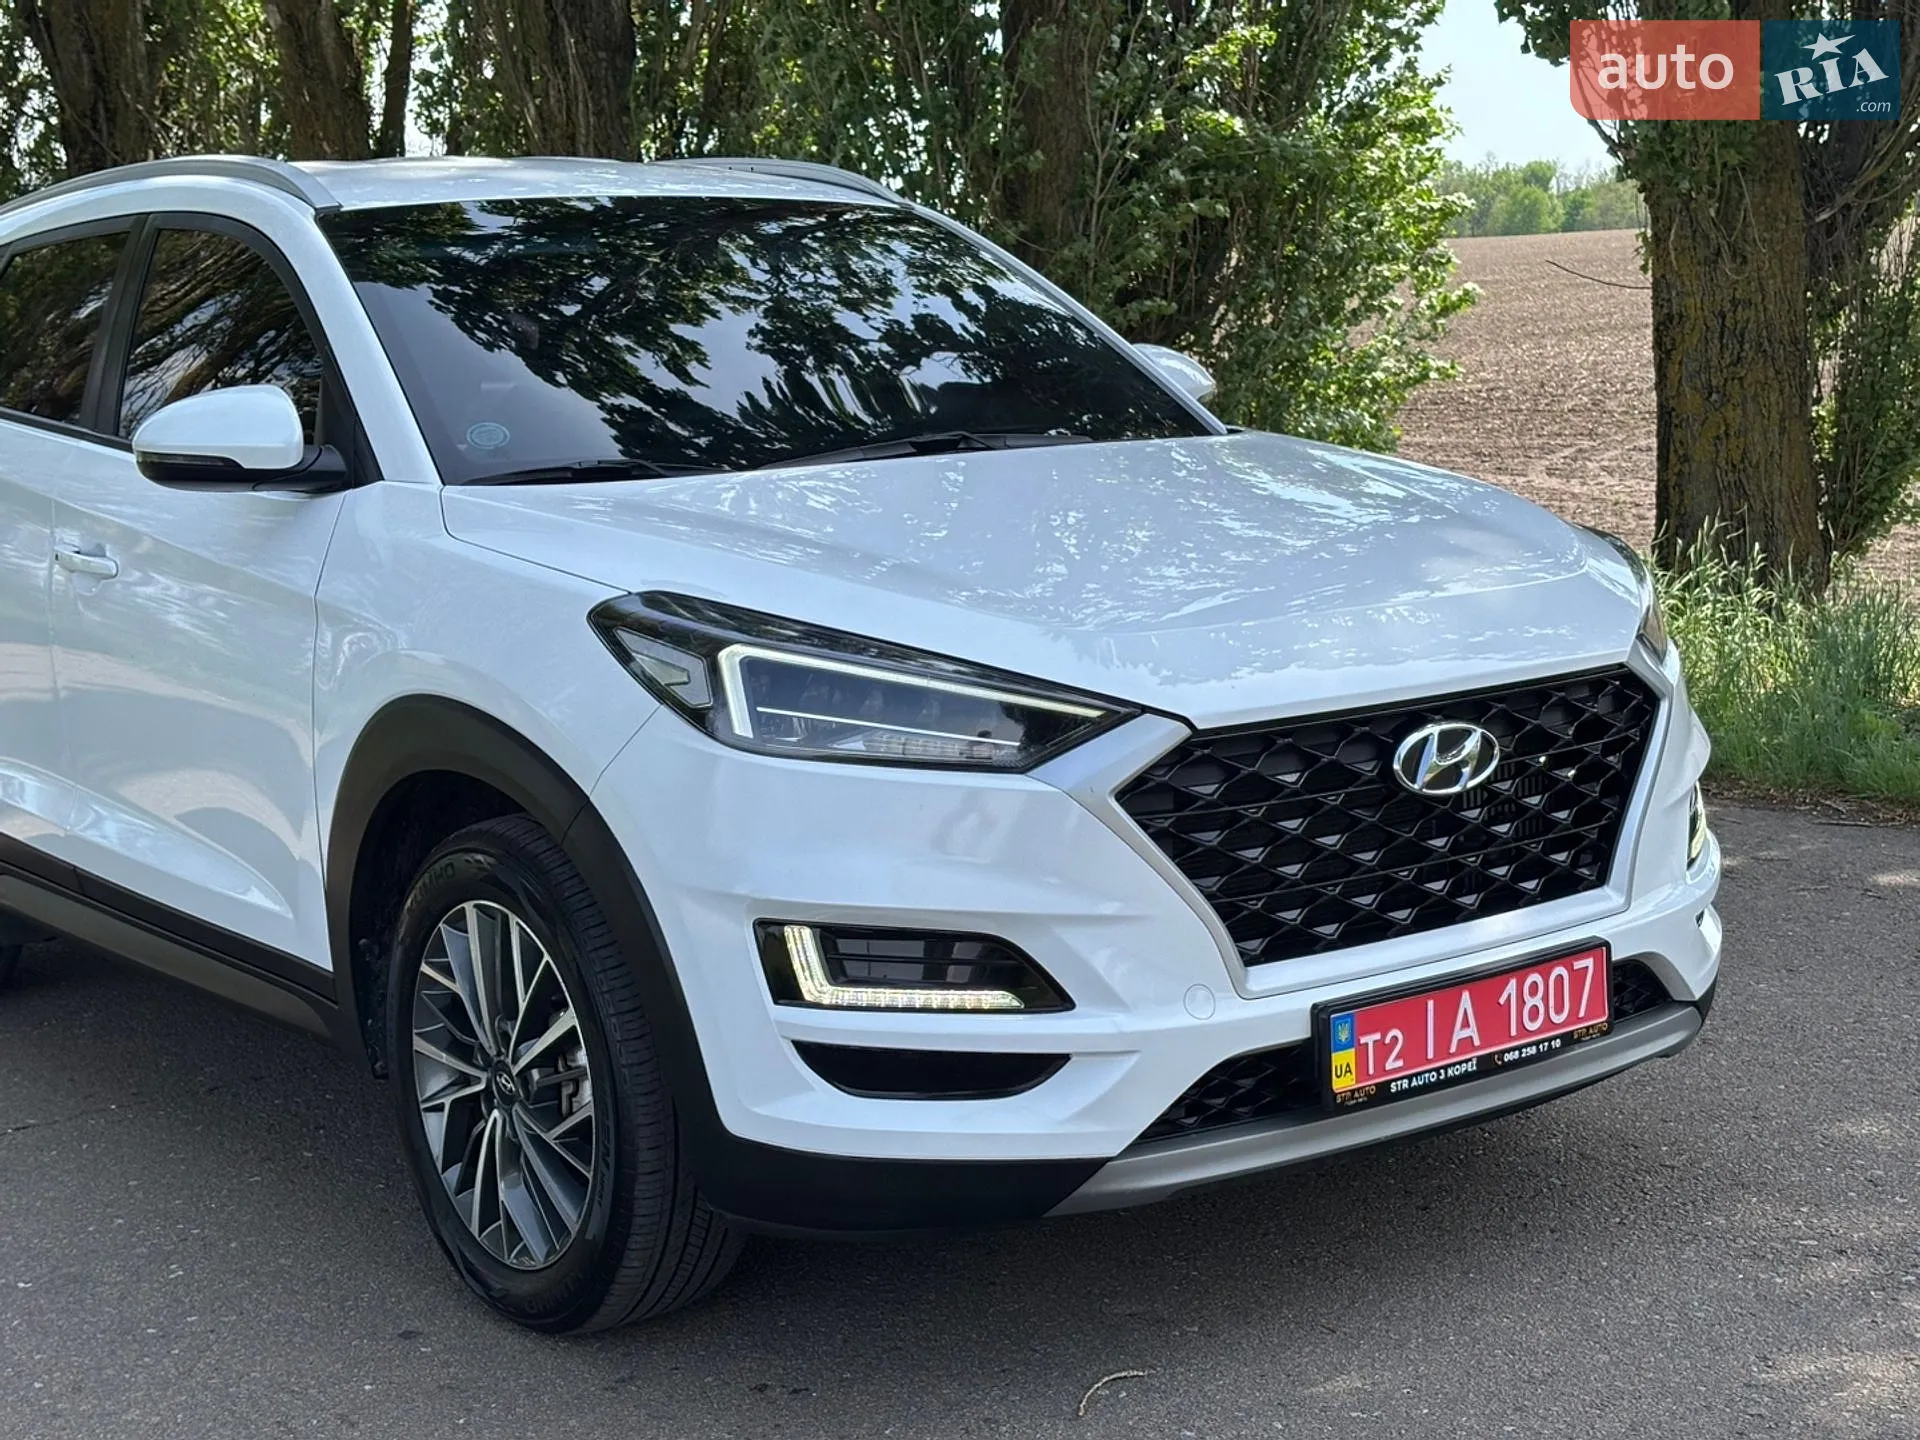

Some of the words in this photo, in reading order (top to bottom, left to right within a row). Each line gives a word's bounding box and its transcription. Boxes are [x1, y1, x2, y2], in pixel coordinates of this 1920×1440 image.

[1359, 1027, 1404, 1076] T2
[1426, 989, 1481, 1060] IA
[1498, 957, 1595, 1037] 1807
[1539, 1041, 1549, 1052] 17
[1334, 1062, 1353, 1079] UA
[1390, 1080, 1409, 1093] STR
[1411, 1072, 1437, 1087] AUTO
